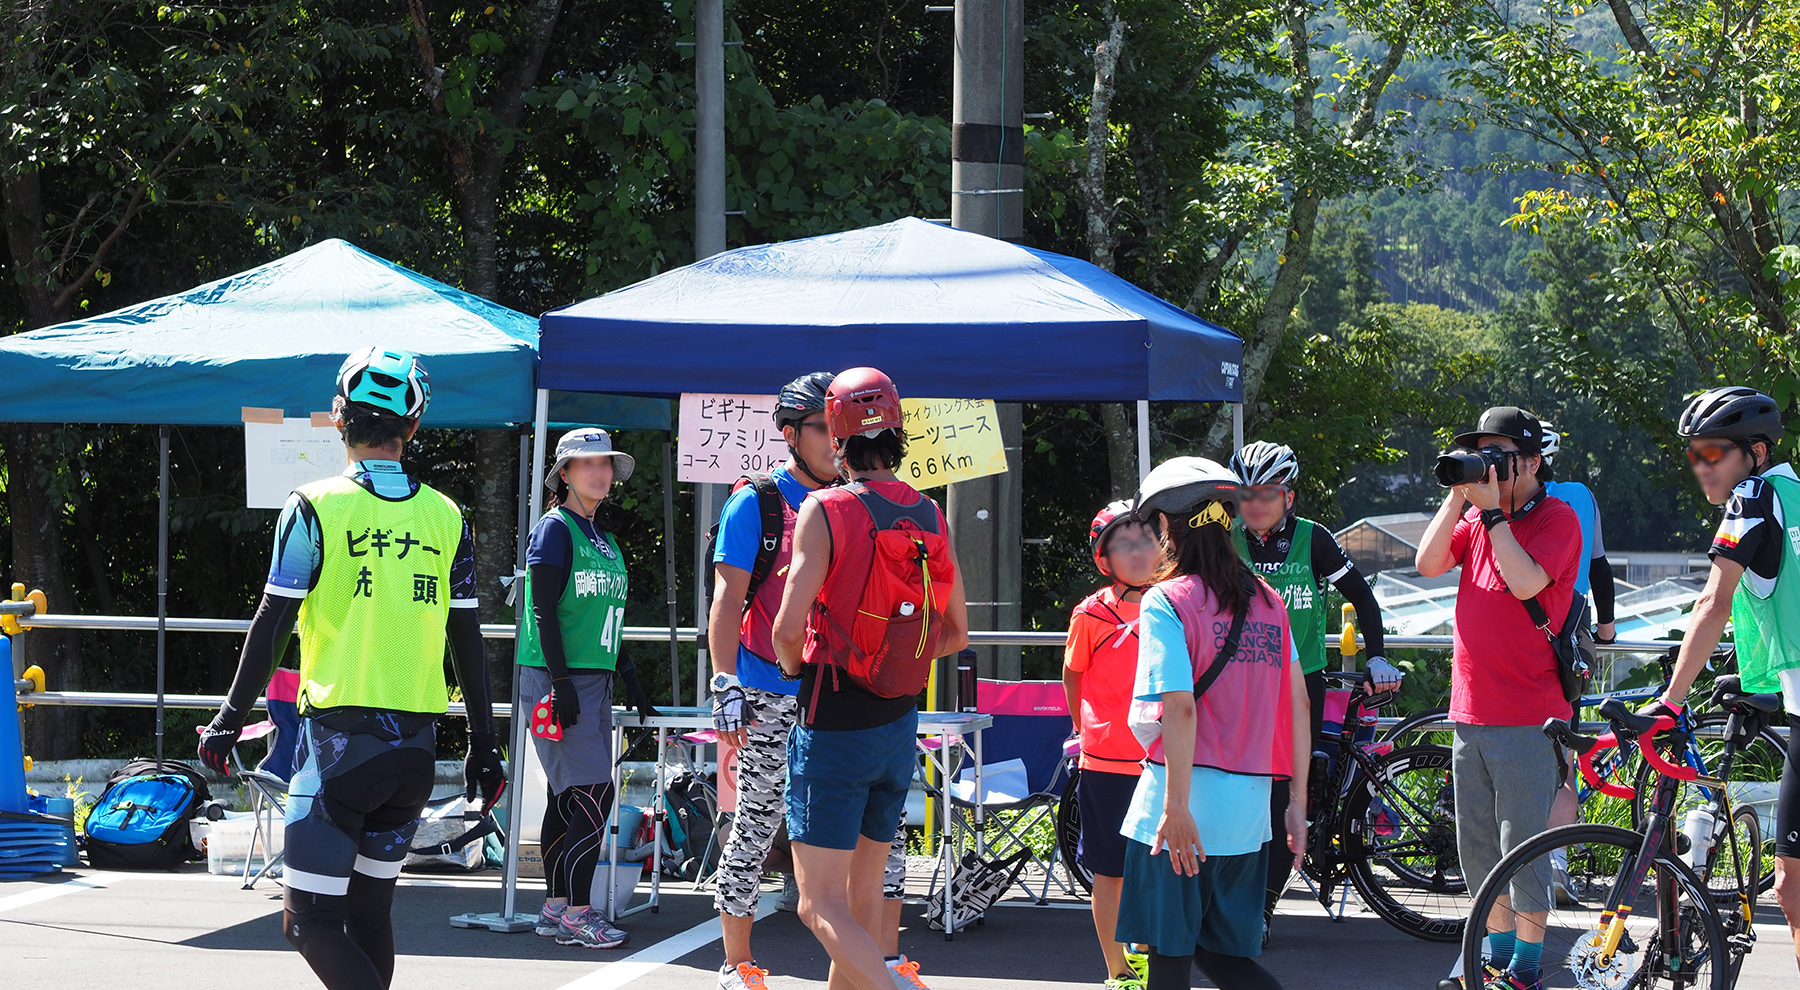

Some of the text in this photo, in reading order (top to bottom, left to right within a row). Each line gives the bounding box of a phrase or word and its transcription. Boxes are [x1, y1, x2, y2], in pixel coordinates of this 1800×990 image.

[700, 428, 786, 451] ファミリー
[683, 454, 787, 471] コース 30k
[910, 453, 973, 478] 66Km
[346, 527, 441, 560] ビギナー
[600, 605, 625, 654] 41
[1629, 829, 1661, 896] FOCUS
